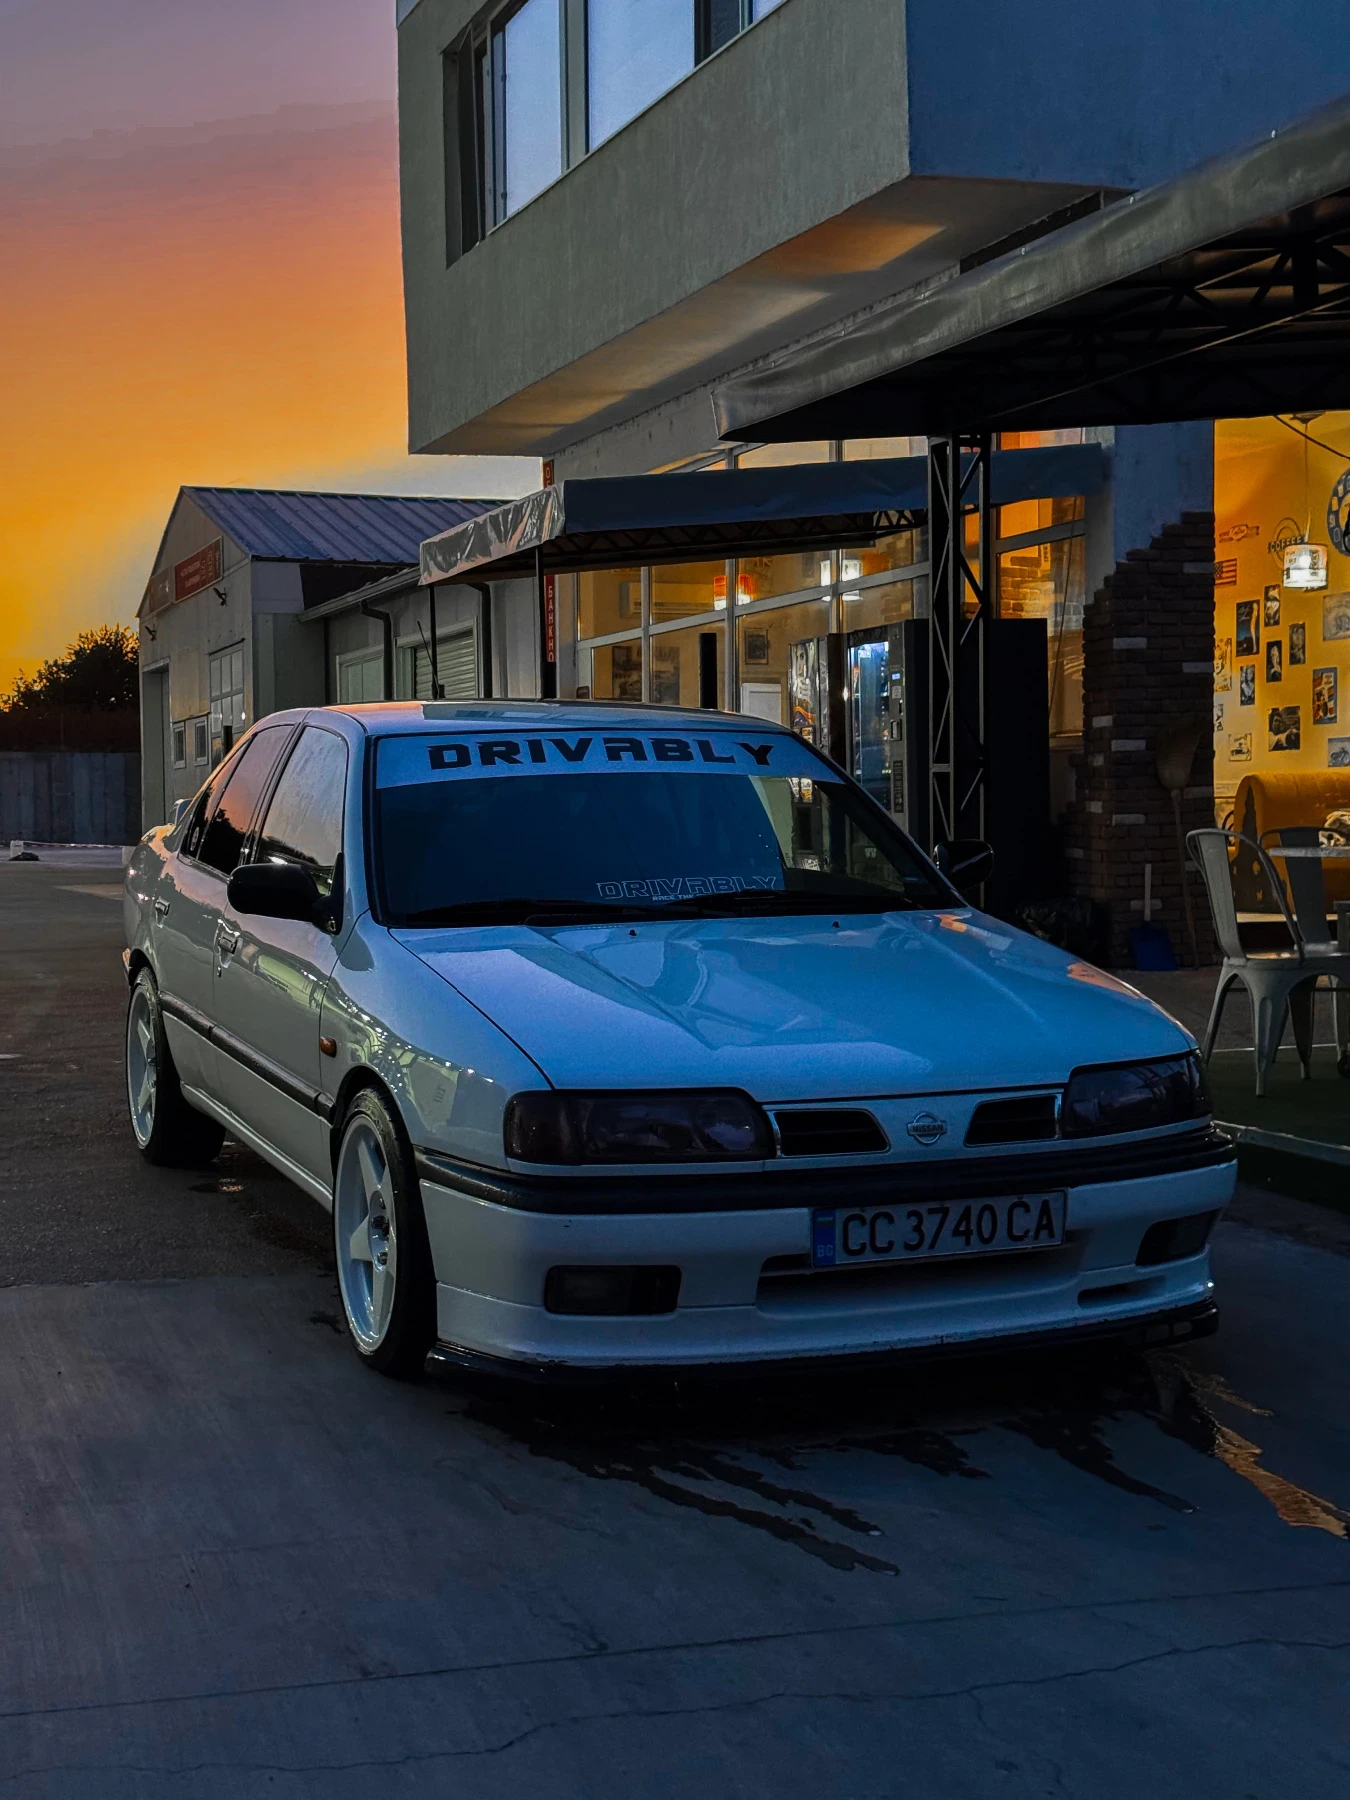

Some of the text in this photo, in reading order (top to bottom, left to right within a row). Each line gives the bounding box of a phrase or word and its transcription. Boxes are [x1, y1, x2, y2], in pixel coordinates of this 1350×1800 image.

[427, 737, 776, 771] DRIVABLY
[595, 876, 777, 900] DRIVABLY
[912, 1124, 944, 1132] NISSAN
[903, 1205, 998, 1252] 3740
[1006, 1199, 1056, 1242] CA
[817, 1243, 834, 1258] BG
